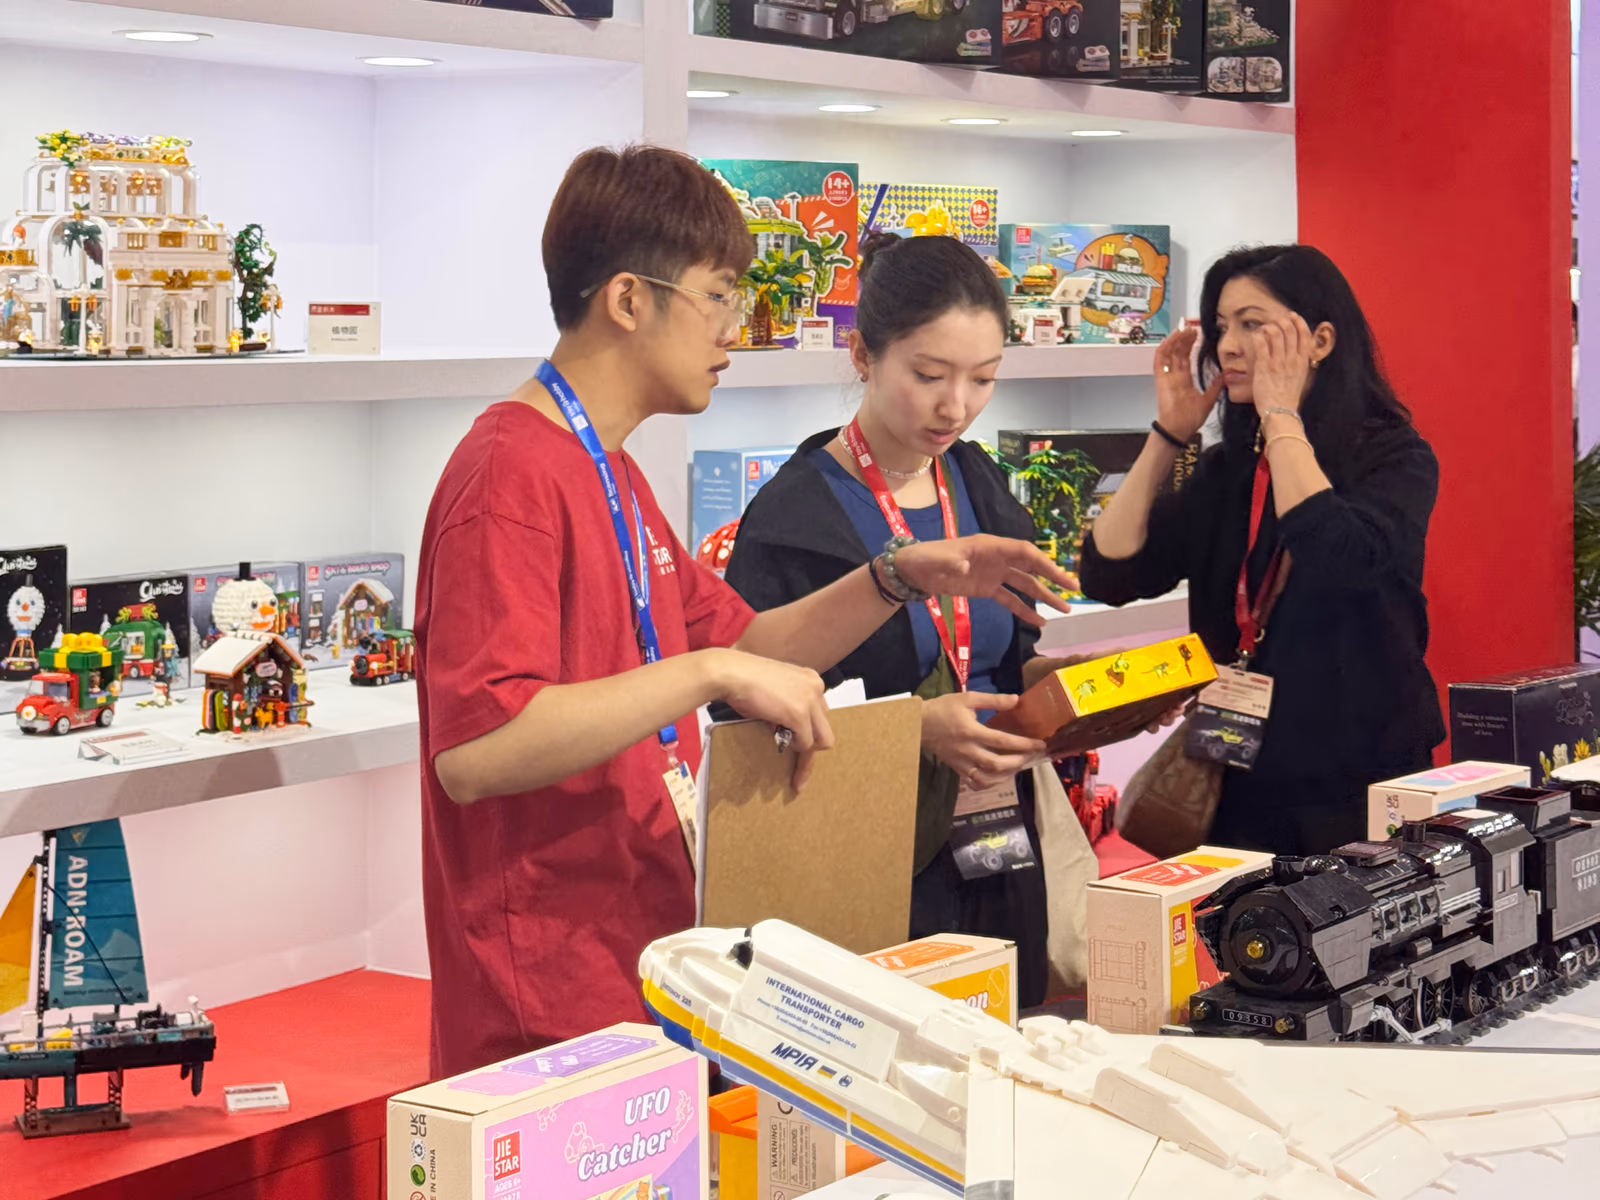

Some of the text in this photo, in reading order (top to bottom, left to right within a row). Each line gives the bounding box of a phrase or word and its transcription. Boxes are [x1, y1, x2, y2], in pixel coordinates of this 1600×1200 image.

[828, 177, 850, 190] 14+
[765, 976, 833, 1015] INTERNATIONAL
[834, 1009, 865, 1029] CARGO
[780, 994, 843, 1031] TRANSPORTER
[1228, 1011, 1268, 1025] 09358
[623, 1085, 671, 1127] UFO
[410, 1112, 419, 1136] UK
[418, 1113, 427, 1138] CA
[495, 1138, 512, 1162] JIE
[577, 1126, 673, 1182] Catcher
[429, 1148, 437, 1193] IN CHINA
[494, 1155, 520, 1177] STAR
[494, 1178, 513, 1194] AGES
